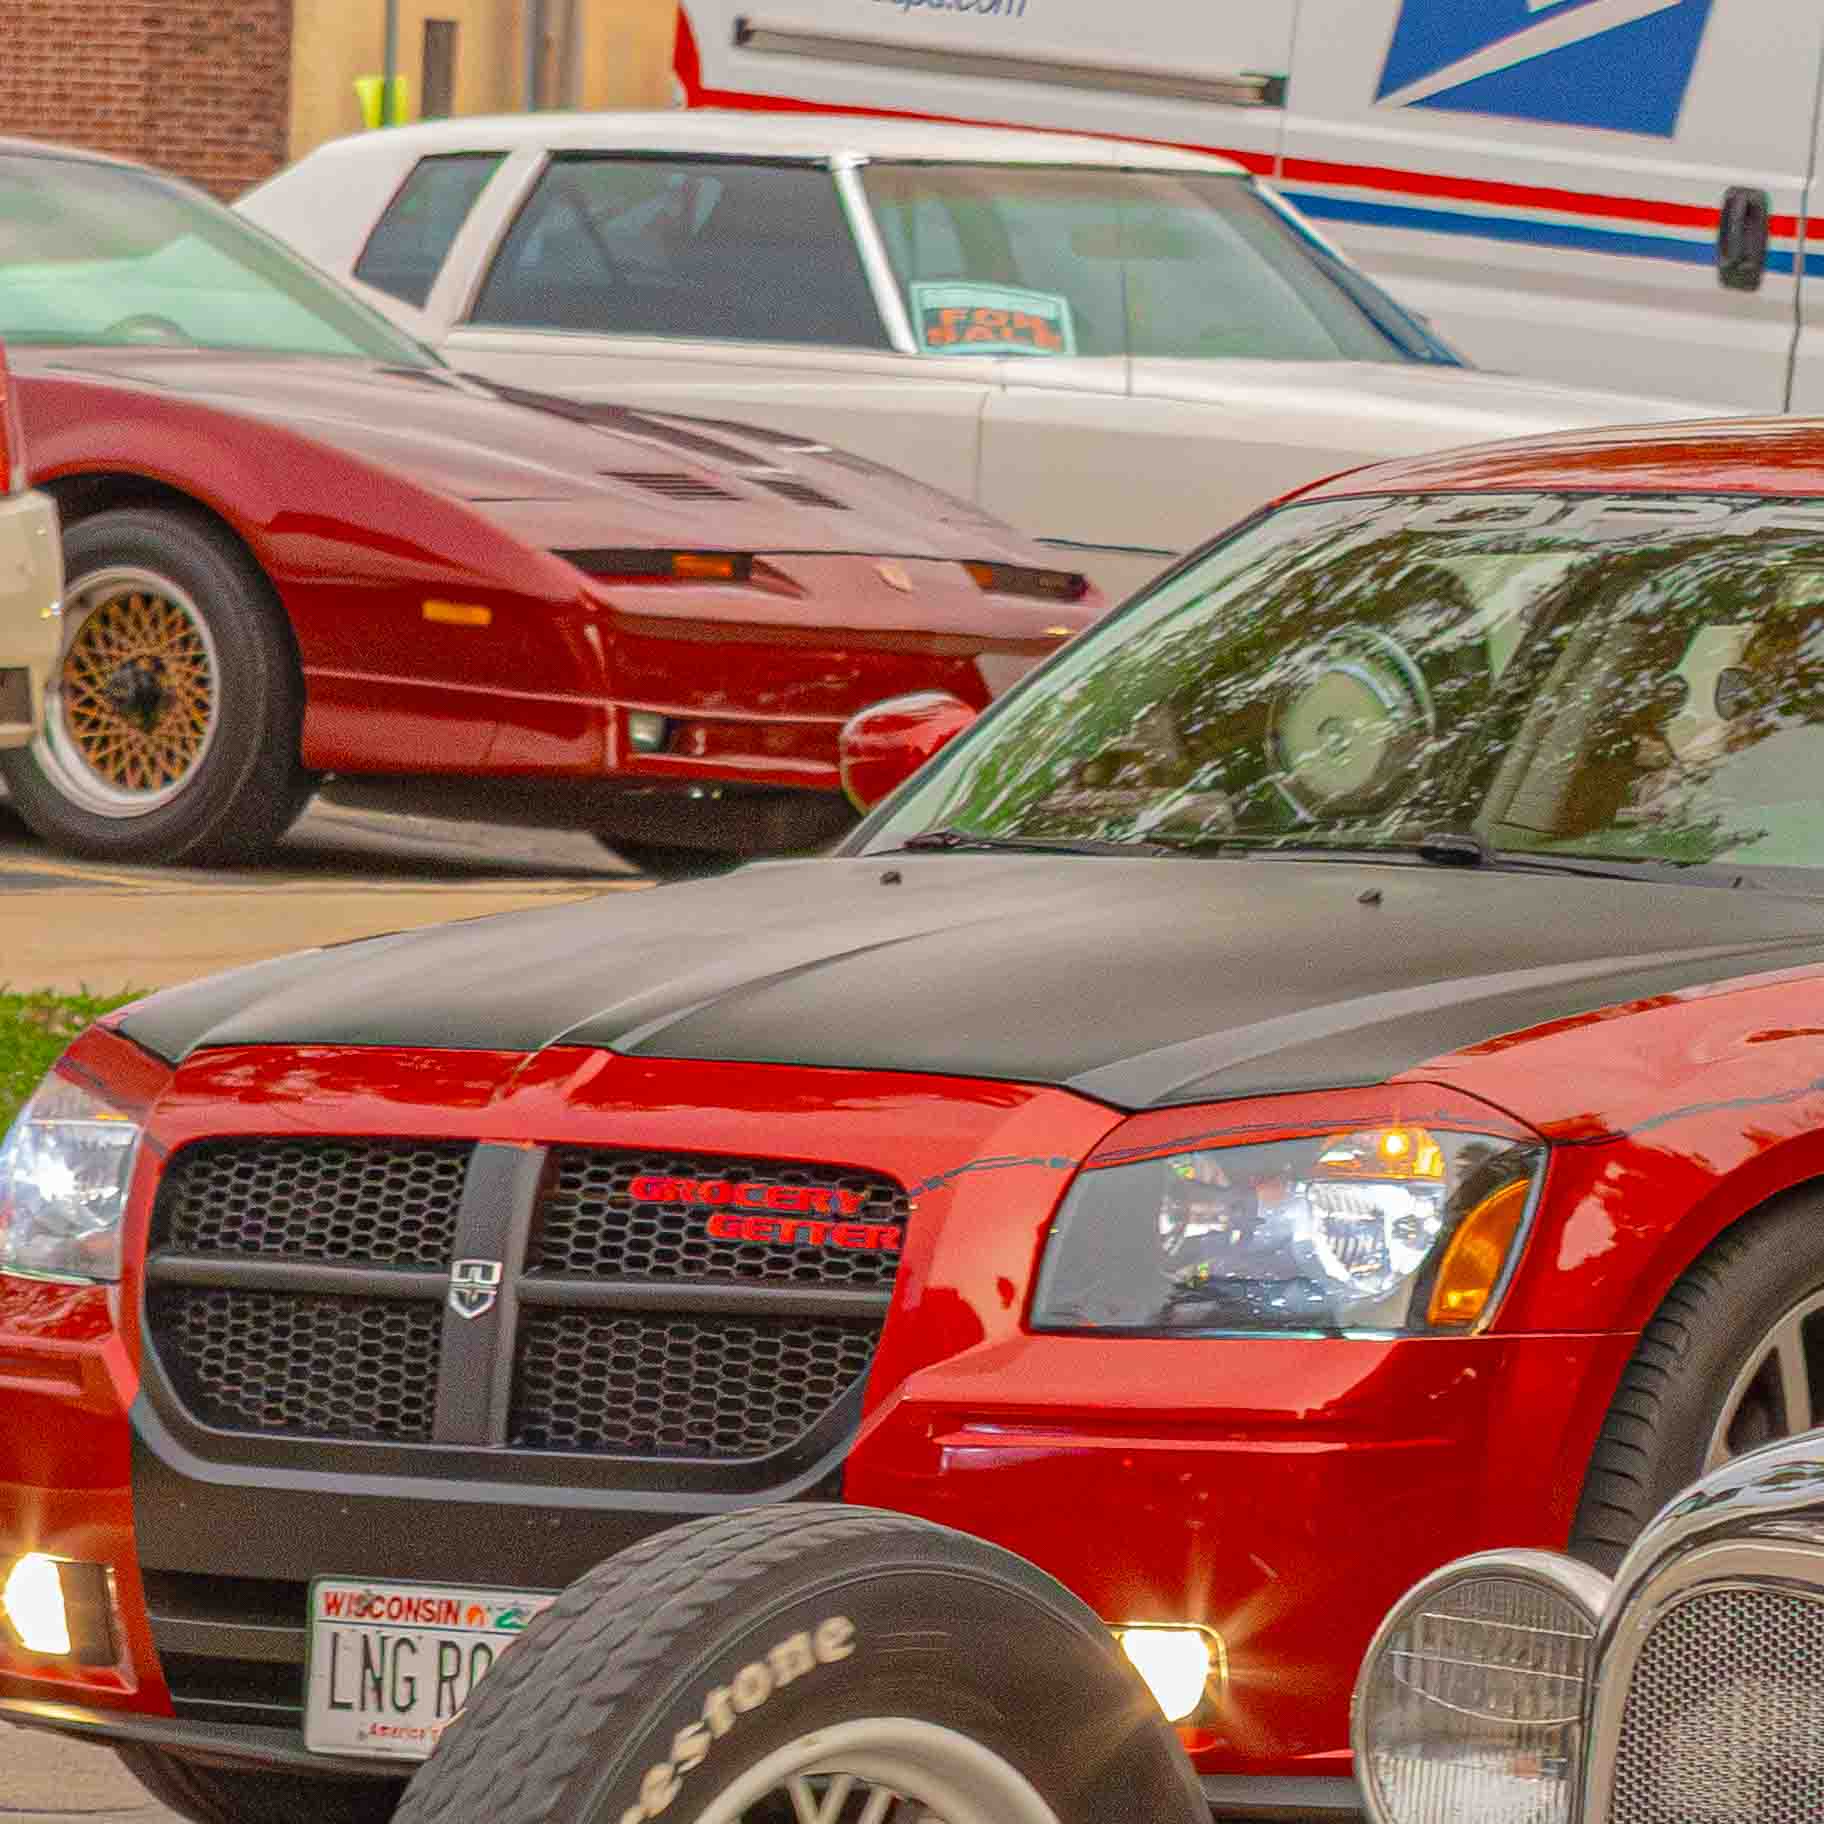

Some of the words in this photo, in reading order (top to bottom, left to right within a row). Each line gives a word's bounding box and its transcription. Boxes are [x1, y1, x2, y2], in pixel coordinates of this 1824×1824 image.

[629, 1175, 867, 1214] GROCERY
[705, 1213, 901, 1250] GETTER
[323, 1591, 461, 1625] WISCONSIN
[330, 1630, 407, 1713] LNG
